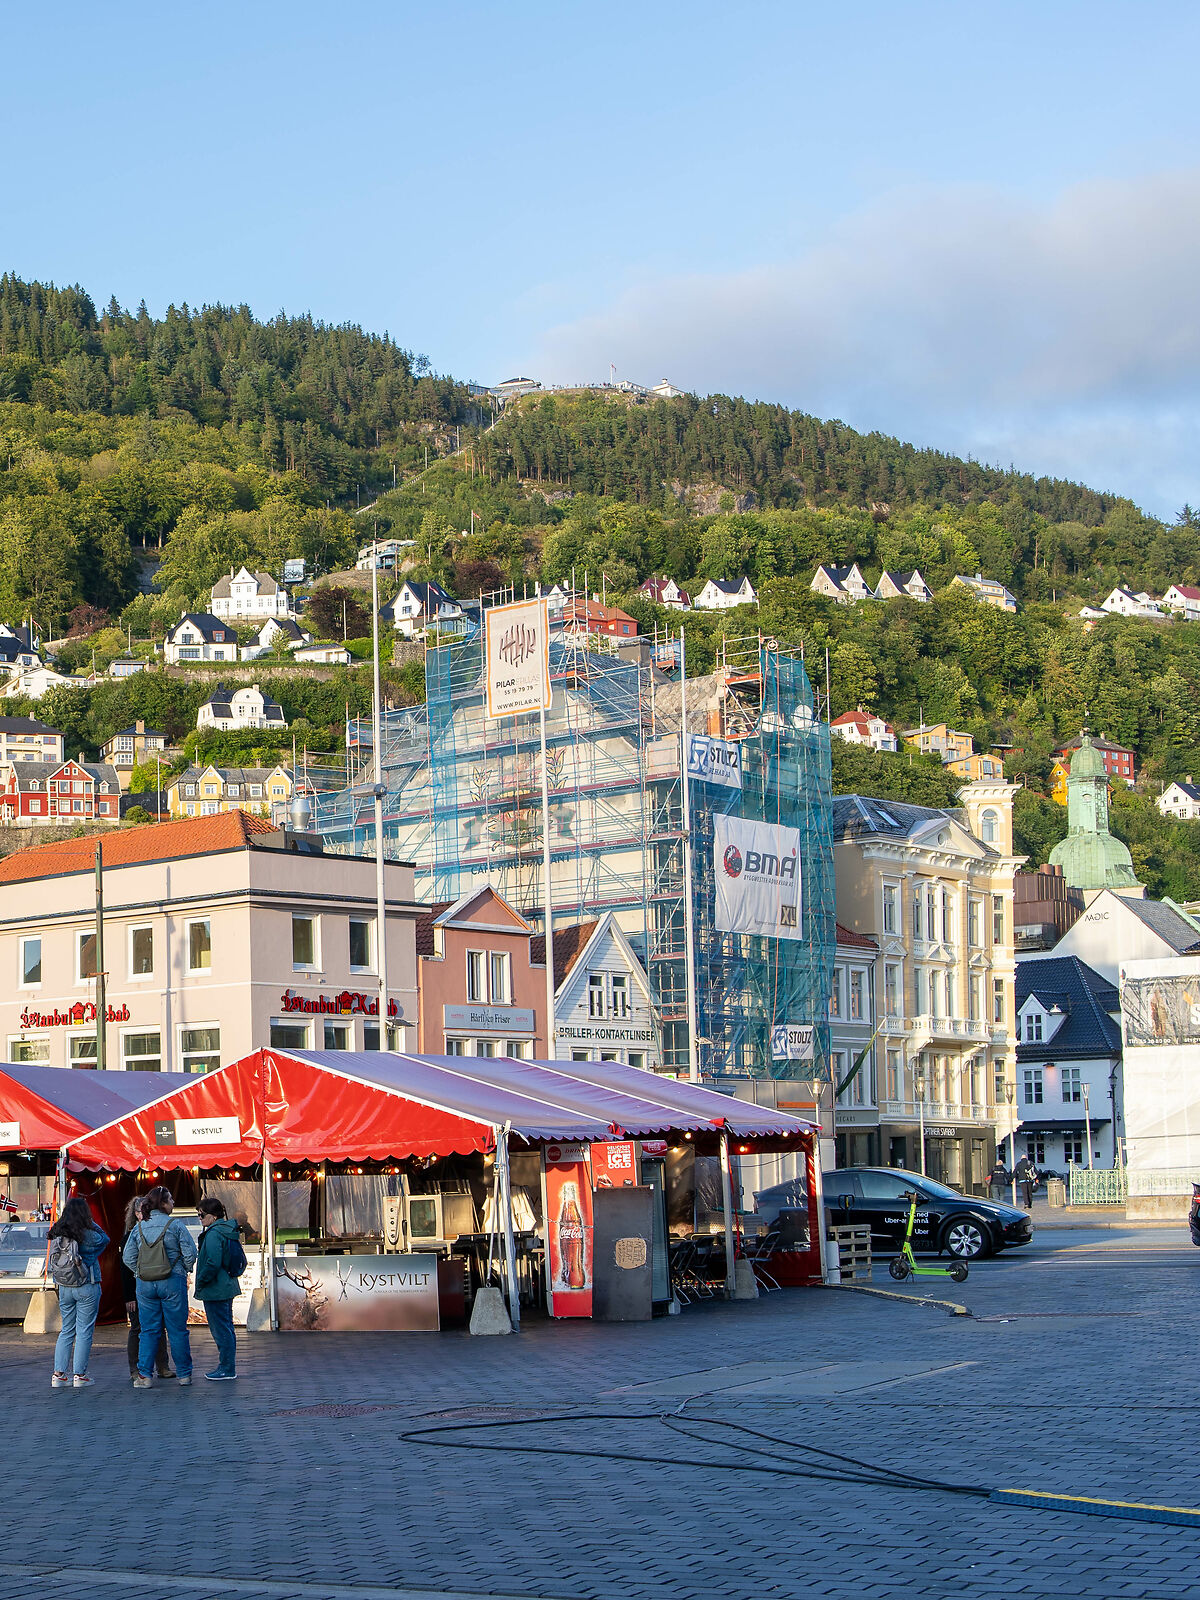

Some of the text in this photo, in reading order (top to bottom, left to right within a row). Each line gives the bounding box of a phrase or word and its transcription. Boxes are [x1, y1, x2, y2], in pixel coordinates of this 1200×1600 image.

[85, 1001, 131, 1023] Kbab
[789, 1031, 812, 1044] STOLTZ
[192, 1127, 223, 1135] KYSTVILT
[608, 1153, 631, 1163] ICE
[560, 1225, 583, 1240] Coca-Col
